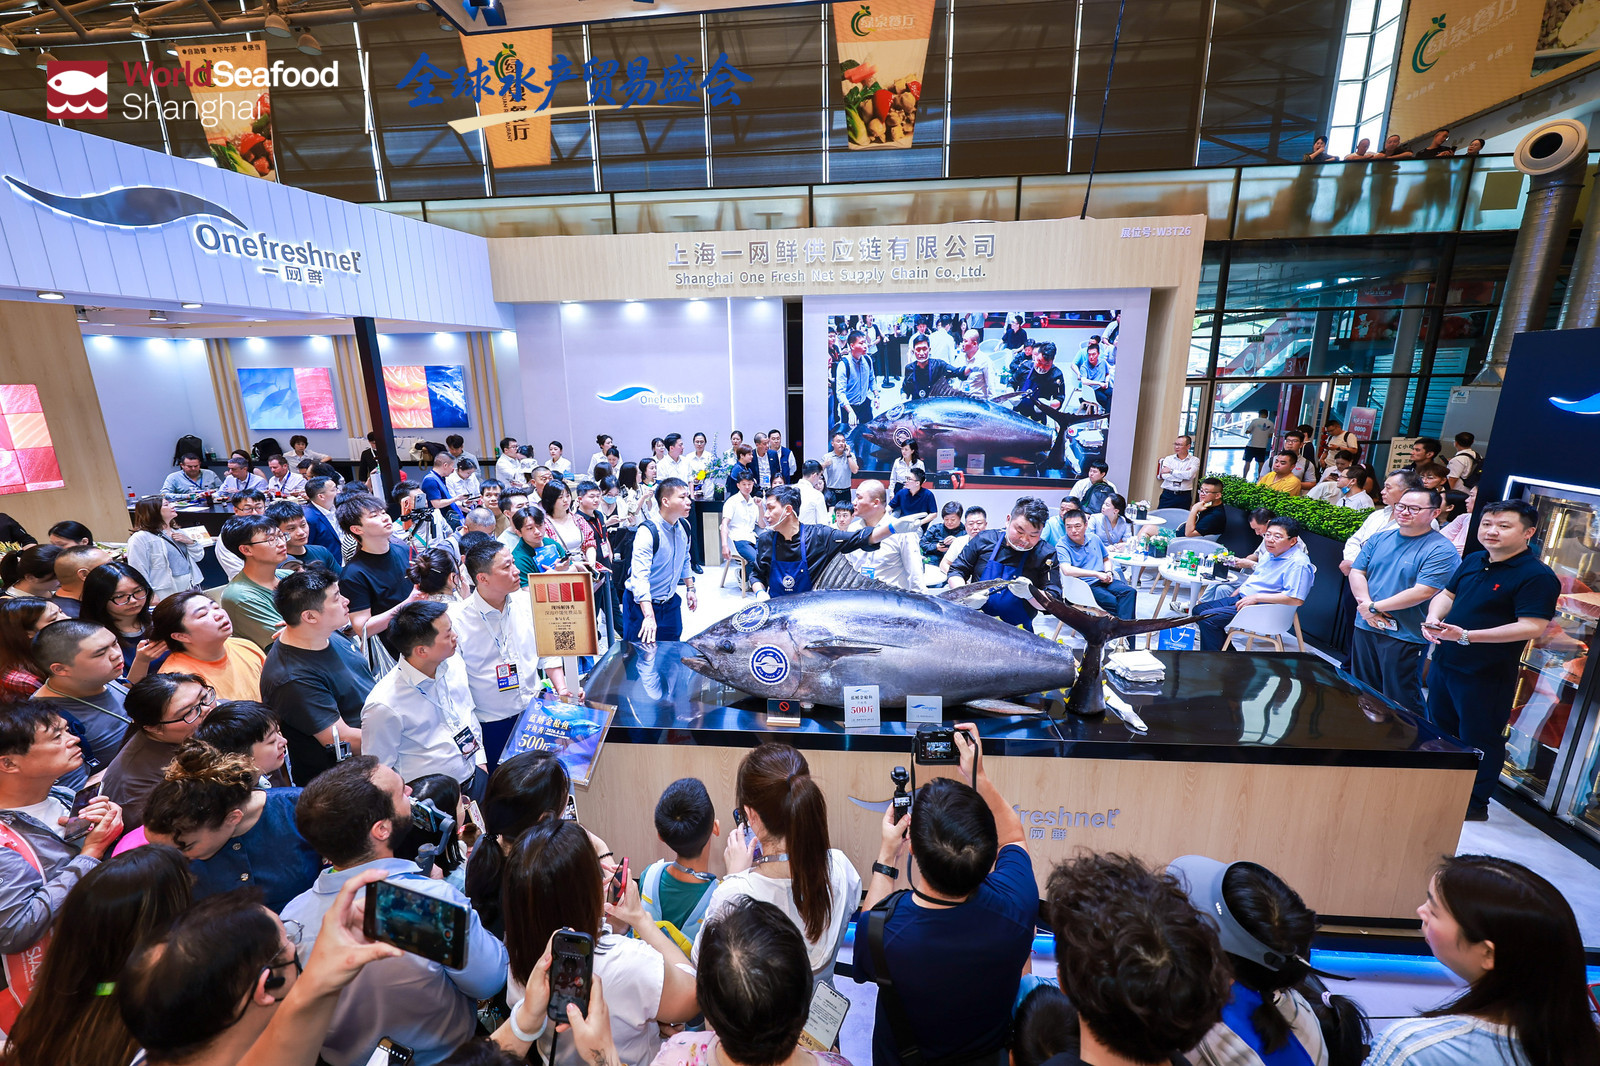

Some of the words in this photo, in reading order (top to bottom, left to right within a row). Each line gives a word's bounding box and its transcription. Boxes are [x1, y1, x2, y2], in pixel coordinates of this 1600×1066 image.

[217, 45, 237, 53] 下午茶
[195, 223, 362, 274] Onefreshnet
[667, 233, 997, 266] 上海一网鲜供应链有限公司
[262, 265, 323, 285] 一网鲜
[675, 271, 734, 288] Shanghai
[740, 271, 765, 284] One
[771, 269, 805, 283] Fresh
[812, 268, 835, 282] Net
[840, 268, 885, 285] Supply
[891, 266, 929, 280] Chain
[935, 264, 987, 281] Co.,Ltd.
[640, 393, 700, 405] Onefreshnet
